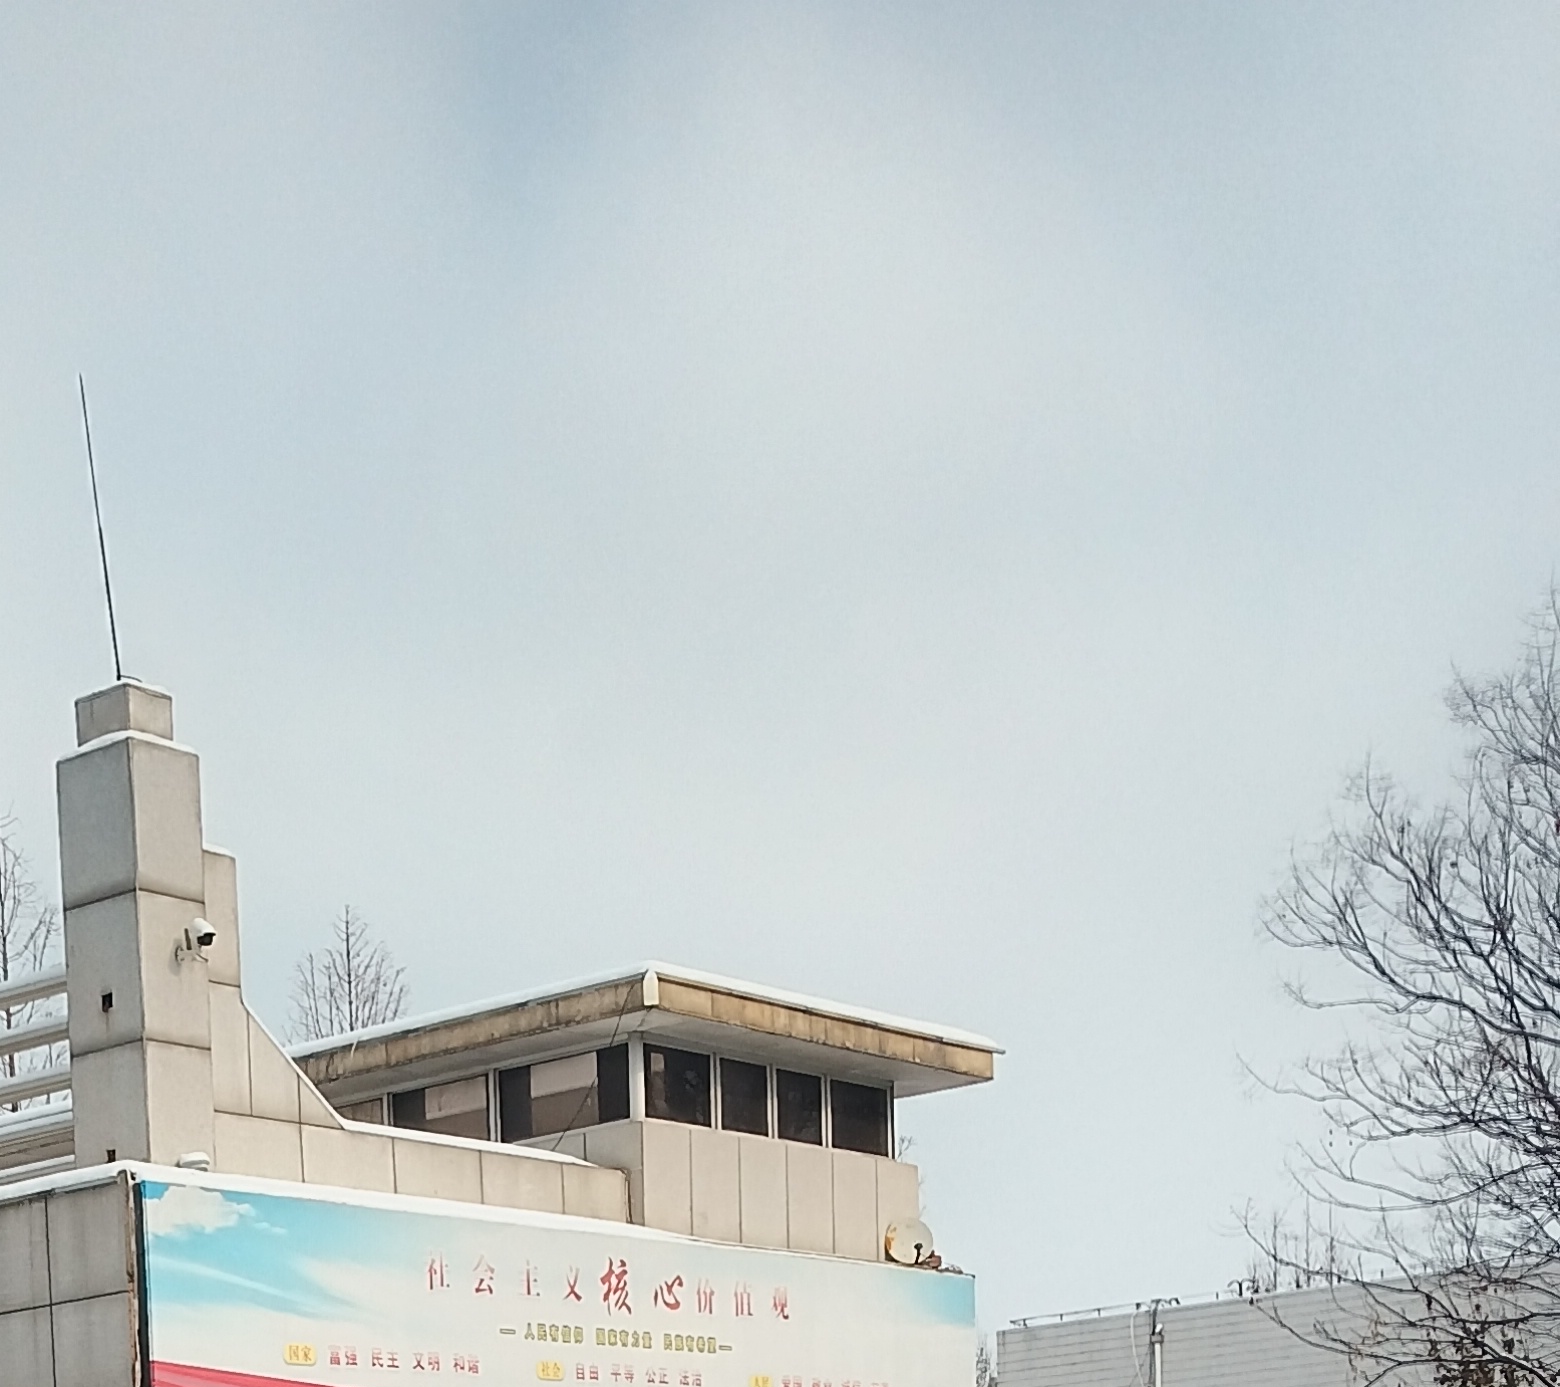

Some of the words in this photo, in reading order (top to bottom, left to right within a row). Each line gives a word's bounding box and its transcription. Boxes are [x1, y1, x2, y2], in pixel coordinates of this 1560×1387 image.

[425, 1249, 791, 1321] 社会主义核心价值观
[524, 1322, 584, 1345] 人民有信仰
[595, 1327, 653, 1350] 国家有力量
[663, 1333, 718, 1354] 民族有希望
[288, 1345, 313, 1363] 国家
[328, 1345, 358, 1367] 富强
[412, 1351, 441, 1372] 文明
[452, 1352, 480, 1375] 和谐
[540, 1361, 561, 1379] 社会
[575, 1362, 600, 1382] 自由
[610, 1363, 635, 1384] 平等
[645, 1366, 670, 1386] 公正
[678, 1368, 703, 1387] 法治
